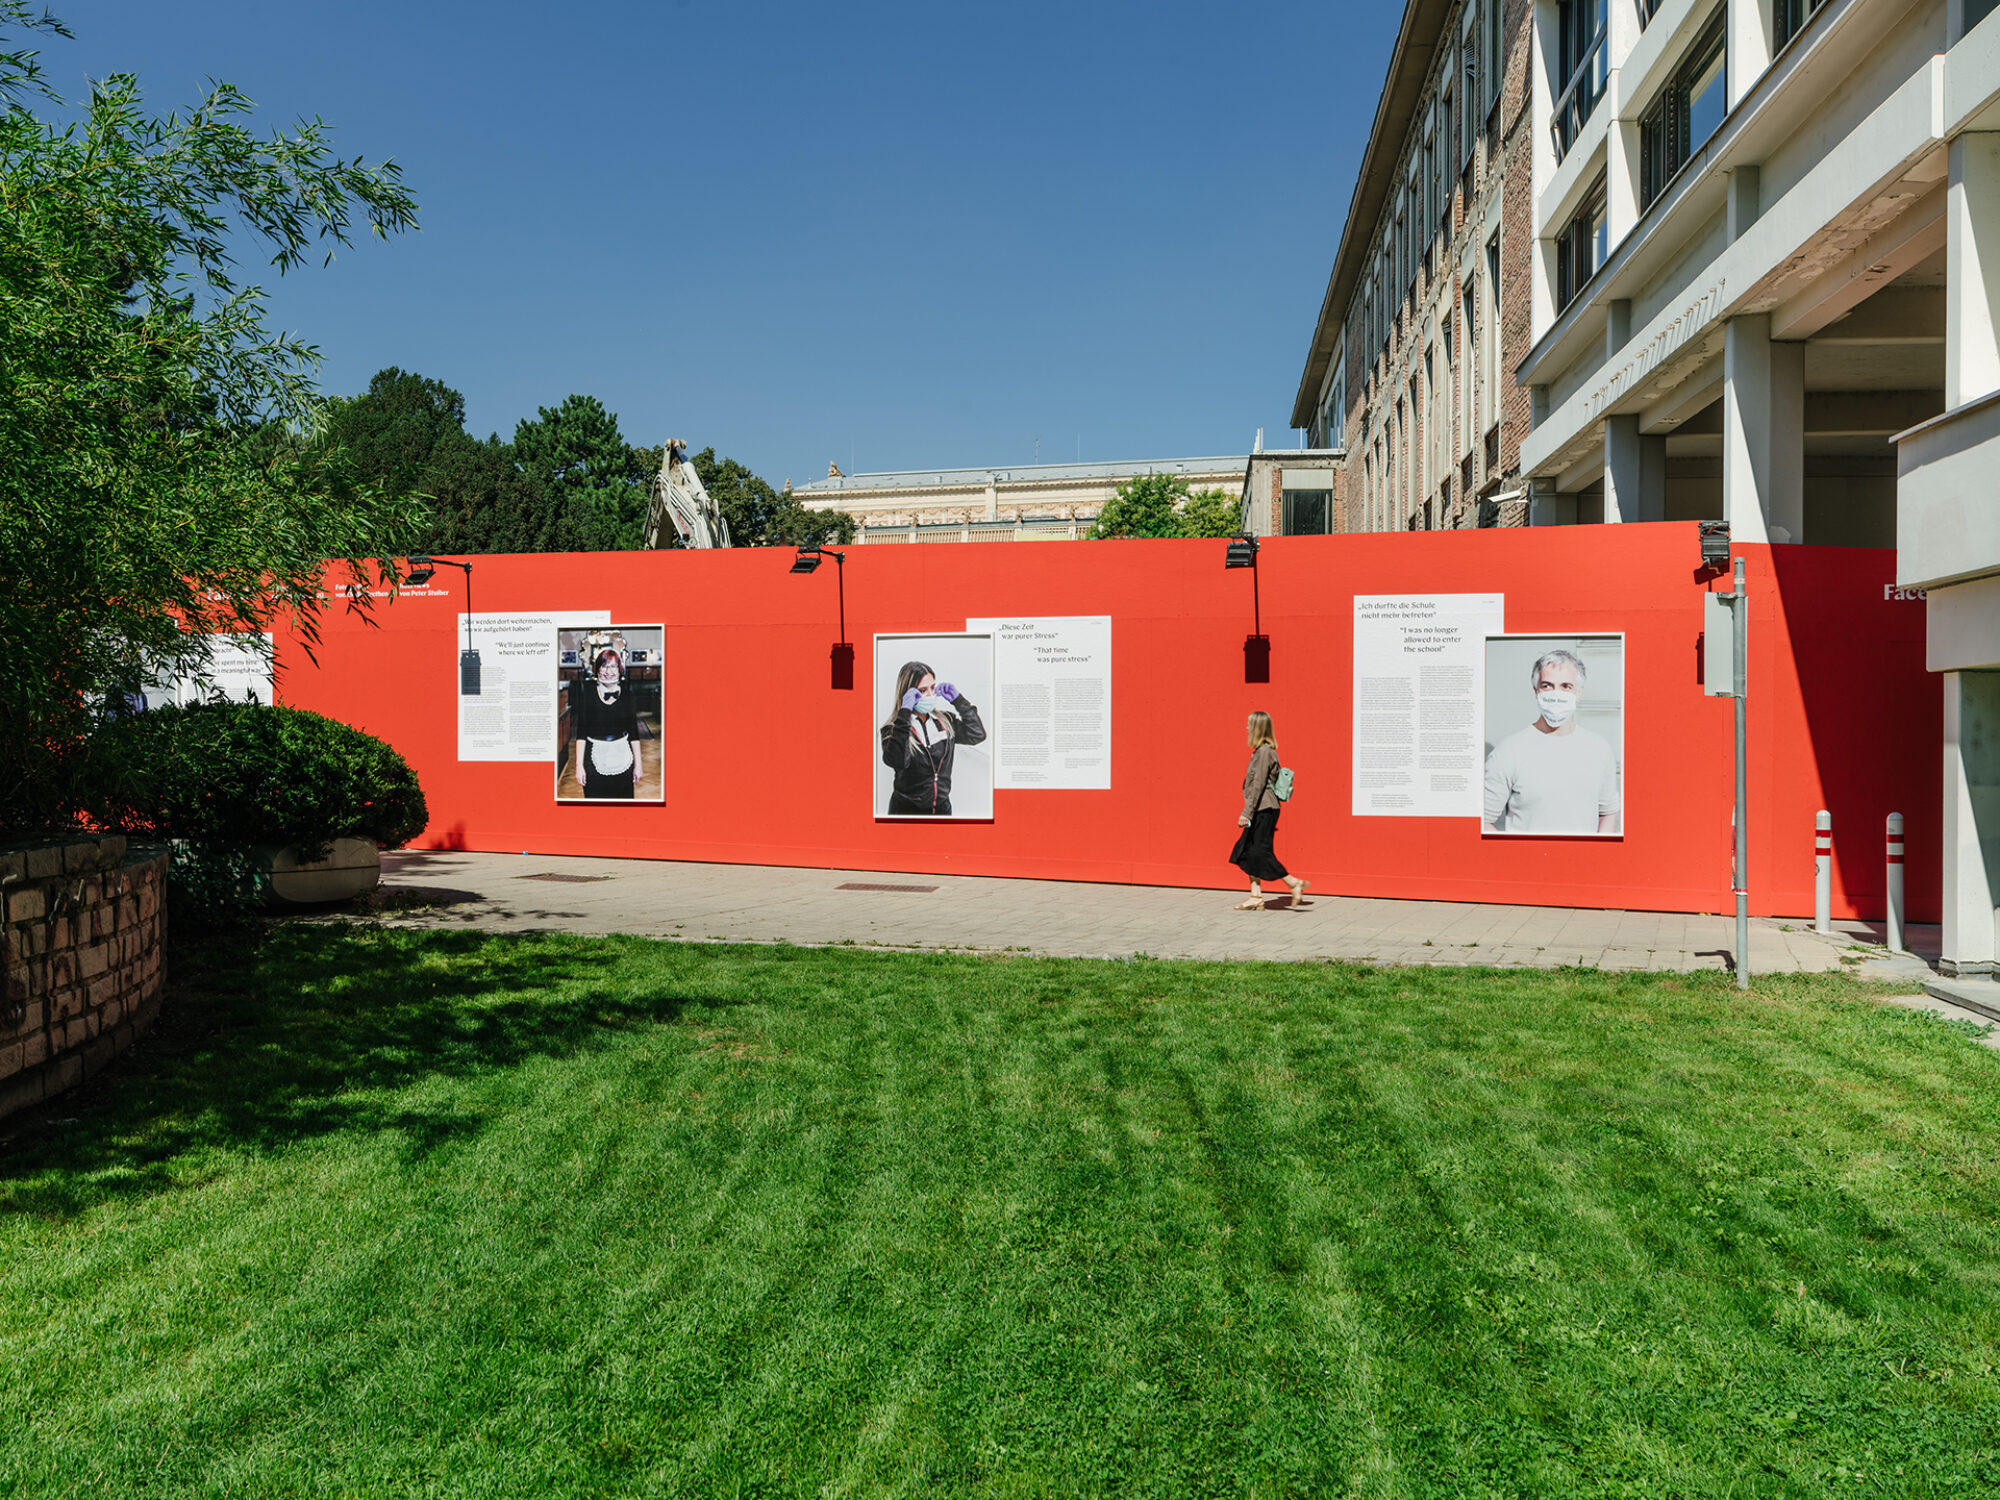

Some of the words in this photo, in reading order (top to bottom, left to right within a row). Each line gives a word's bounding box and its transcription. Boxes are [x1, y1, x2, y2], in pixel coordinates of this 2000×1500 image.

[428, 589, 449, 597] Stuiber
[1884, 584, 1928, 600] Face
[483, 626, 511, 634] aufgehört
[1021, 623, 1035, 631] Zeit
[1434, 626, 1459, 635] longer
[1015, 633, 1033, 641] purer
[513, 641, 525, 649] just
[1403, 645, 1416, 653] the
[1053, 646, 1069, 654] time
[1050, 656, 1067, 664] pure
